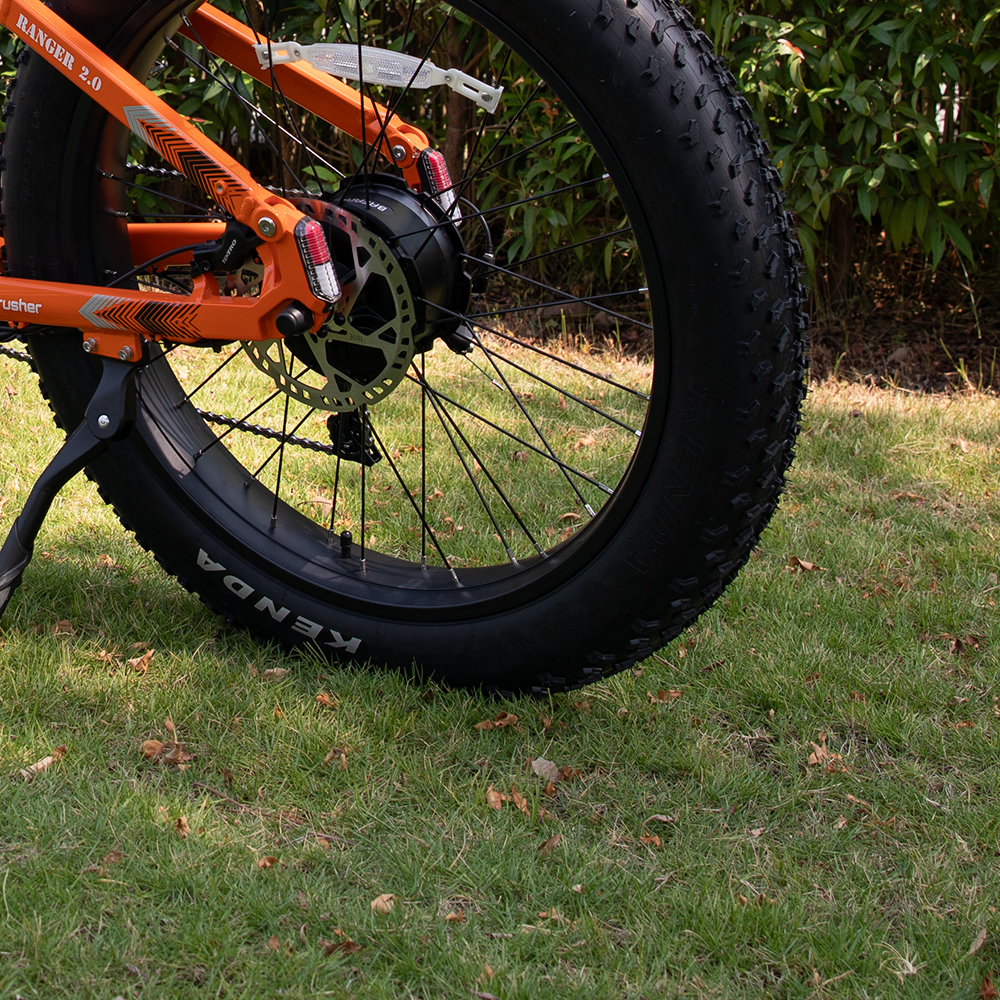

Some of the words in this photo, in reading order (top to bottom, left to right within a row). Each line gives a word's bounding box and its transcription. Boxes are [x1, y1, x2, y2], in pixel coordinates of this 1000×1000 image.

[16, 13, 75, 70] RANGER
[79, 66, 102, 91] 2.0
[197, 548, 362, 654] KENDA
